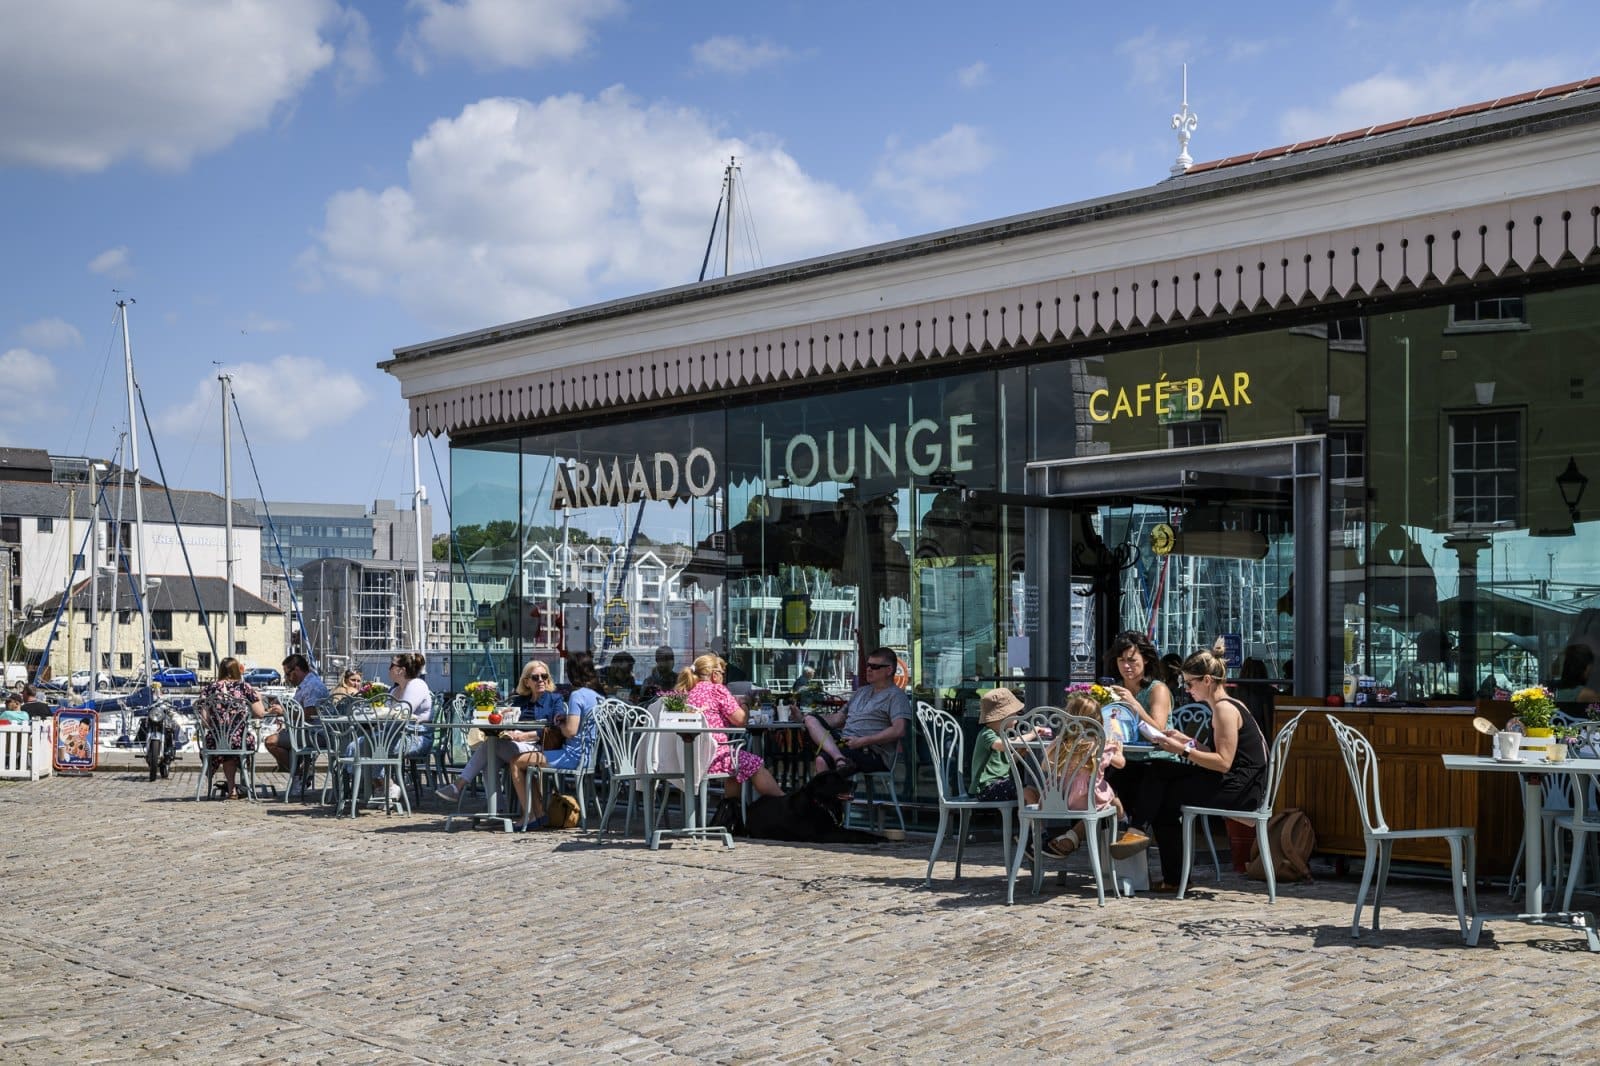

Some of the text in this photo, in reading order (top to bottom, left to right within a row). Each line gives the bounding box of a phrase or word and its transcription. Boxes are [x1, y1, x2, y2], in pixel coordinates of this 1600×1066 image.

[1088, 372, 1252, 422] CAFÉ BAR
[550, 413, 977, 510] ARMADO LOUNGE
